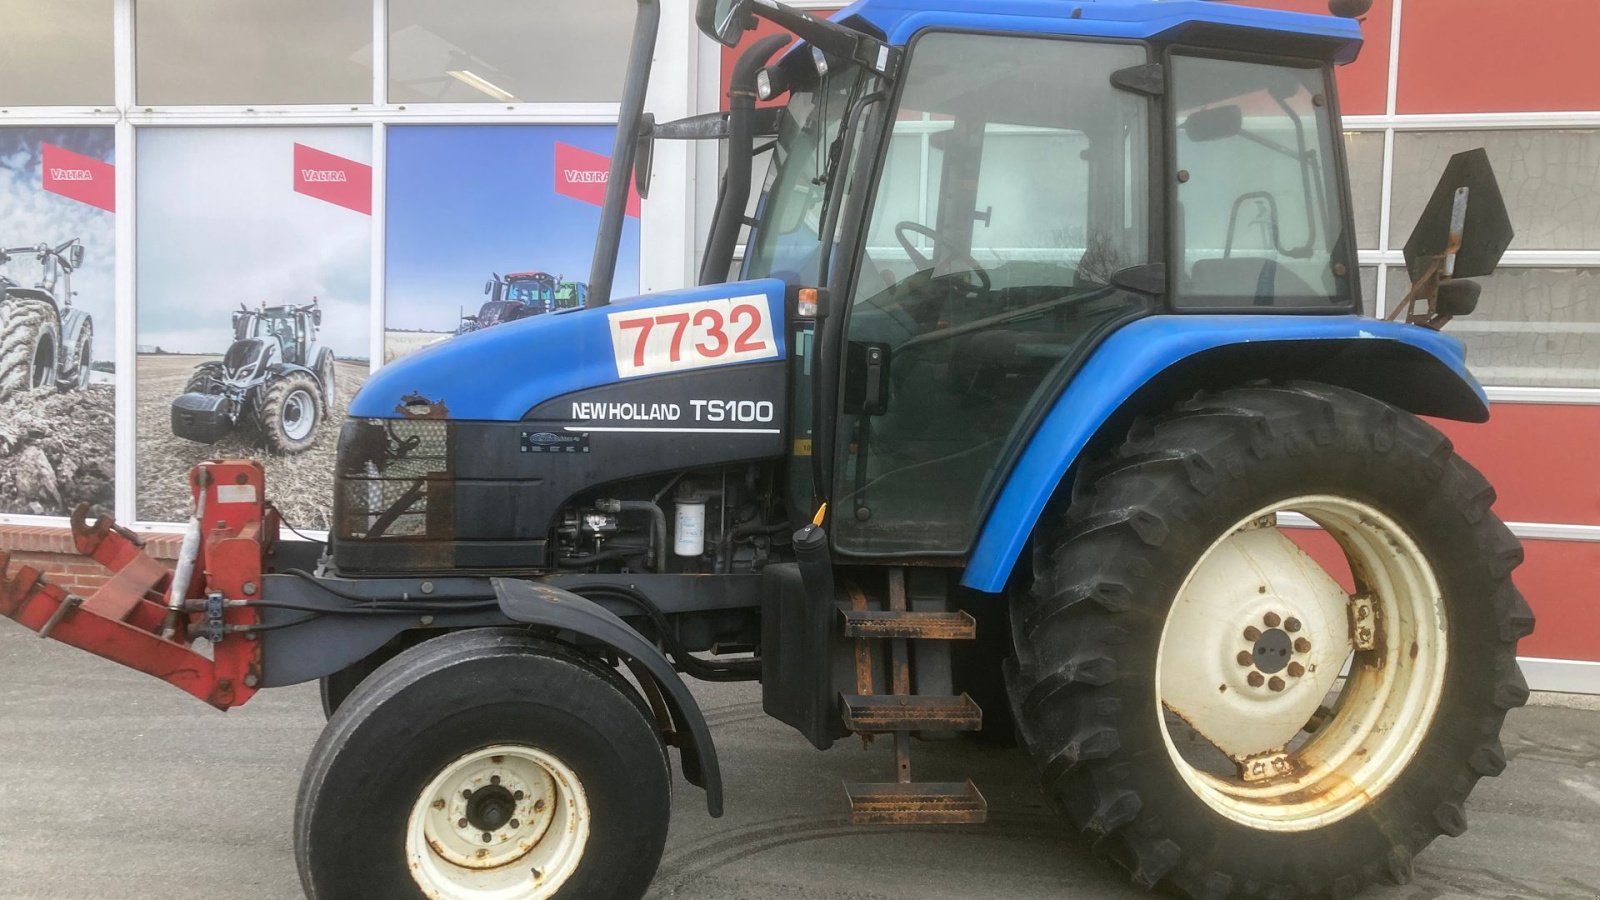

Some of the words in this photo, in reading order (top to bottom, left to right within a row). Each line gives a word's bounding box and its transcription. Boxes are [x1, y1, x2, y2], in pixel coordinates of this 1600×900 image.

[50, 168, 93, 181] VALTRA
[301, 169, 347, 182] VALTRA
[619, 304, 766, 367] 7732
[572, 402, 607, 419] NEW
[610, 403, 680, 420] HOLLAND
[690, 399, 773, 421] TS100
